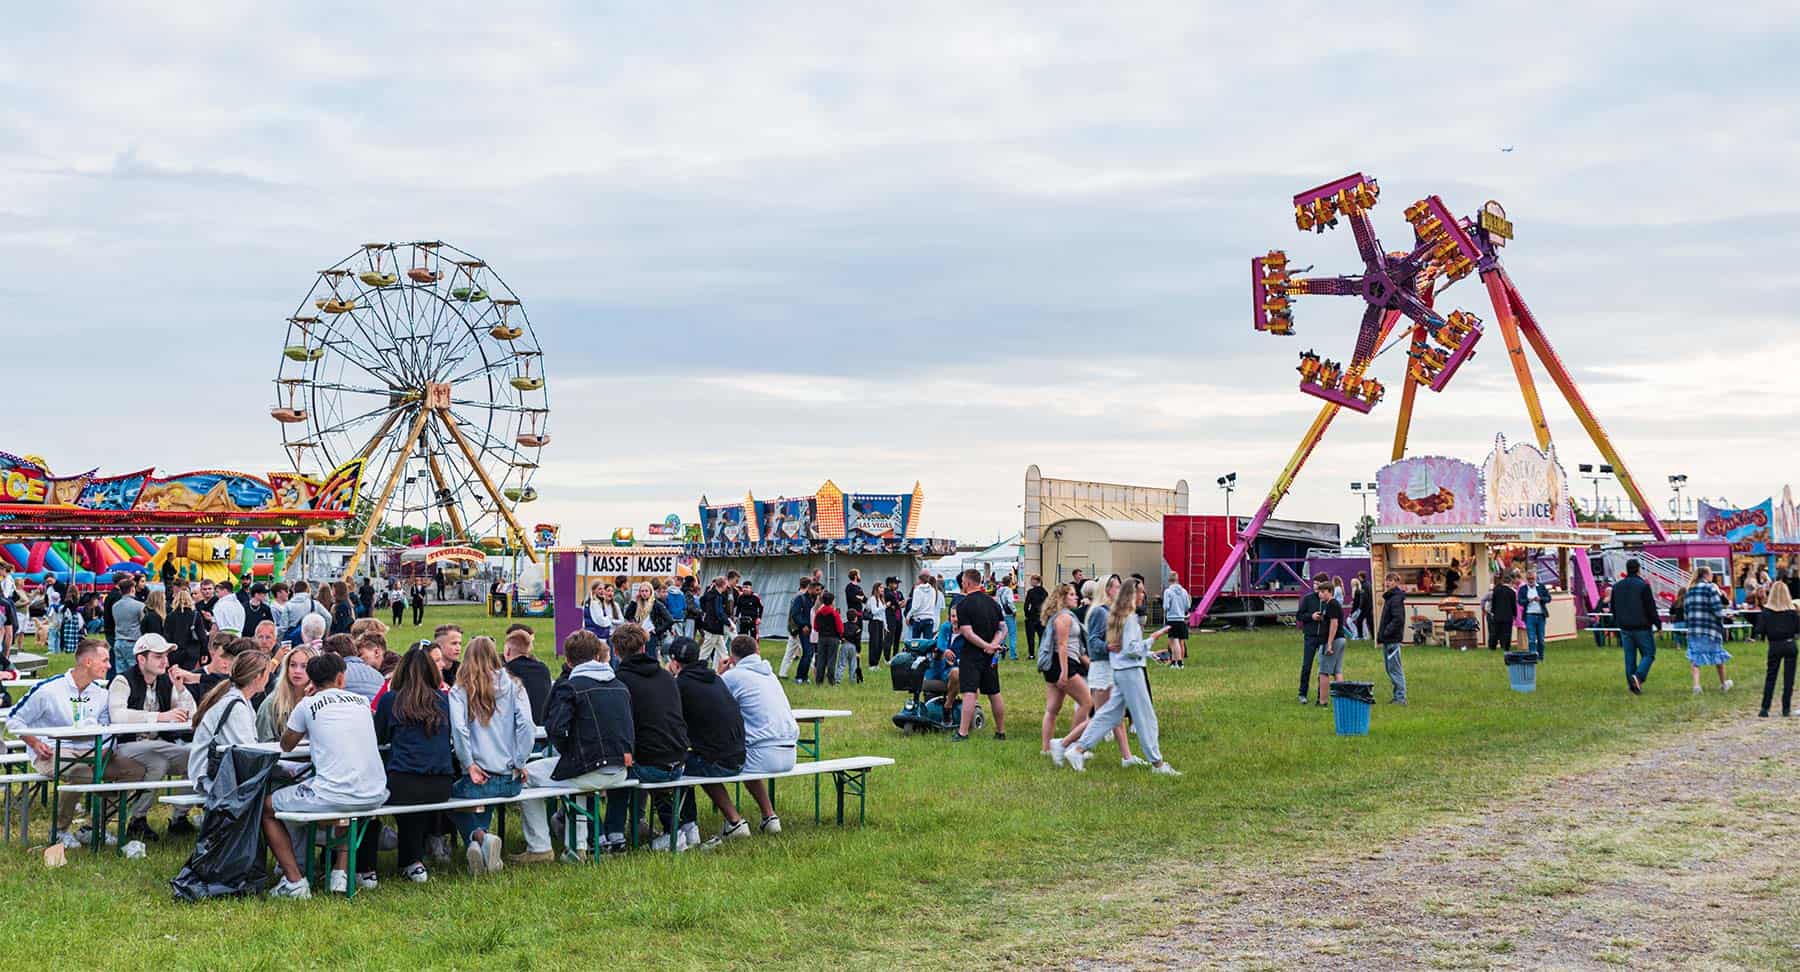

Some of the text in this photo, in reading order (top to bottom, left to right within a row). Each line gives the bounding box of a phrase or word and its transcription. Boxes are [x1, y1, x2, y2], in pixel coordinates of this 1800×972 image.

[0, 471, 46, 502] CE
[1501, 503, 1551, 518] SOFTICE
[592, 556, 672, 572] KASSE KASSE
